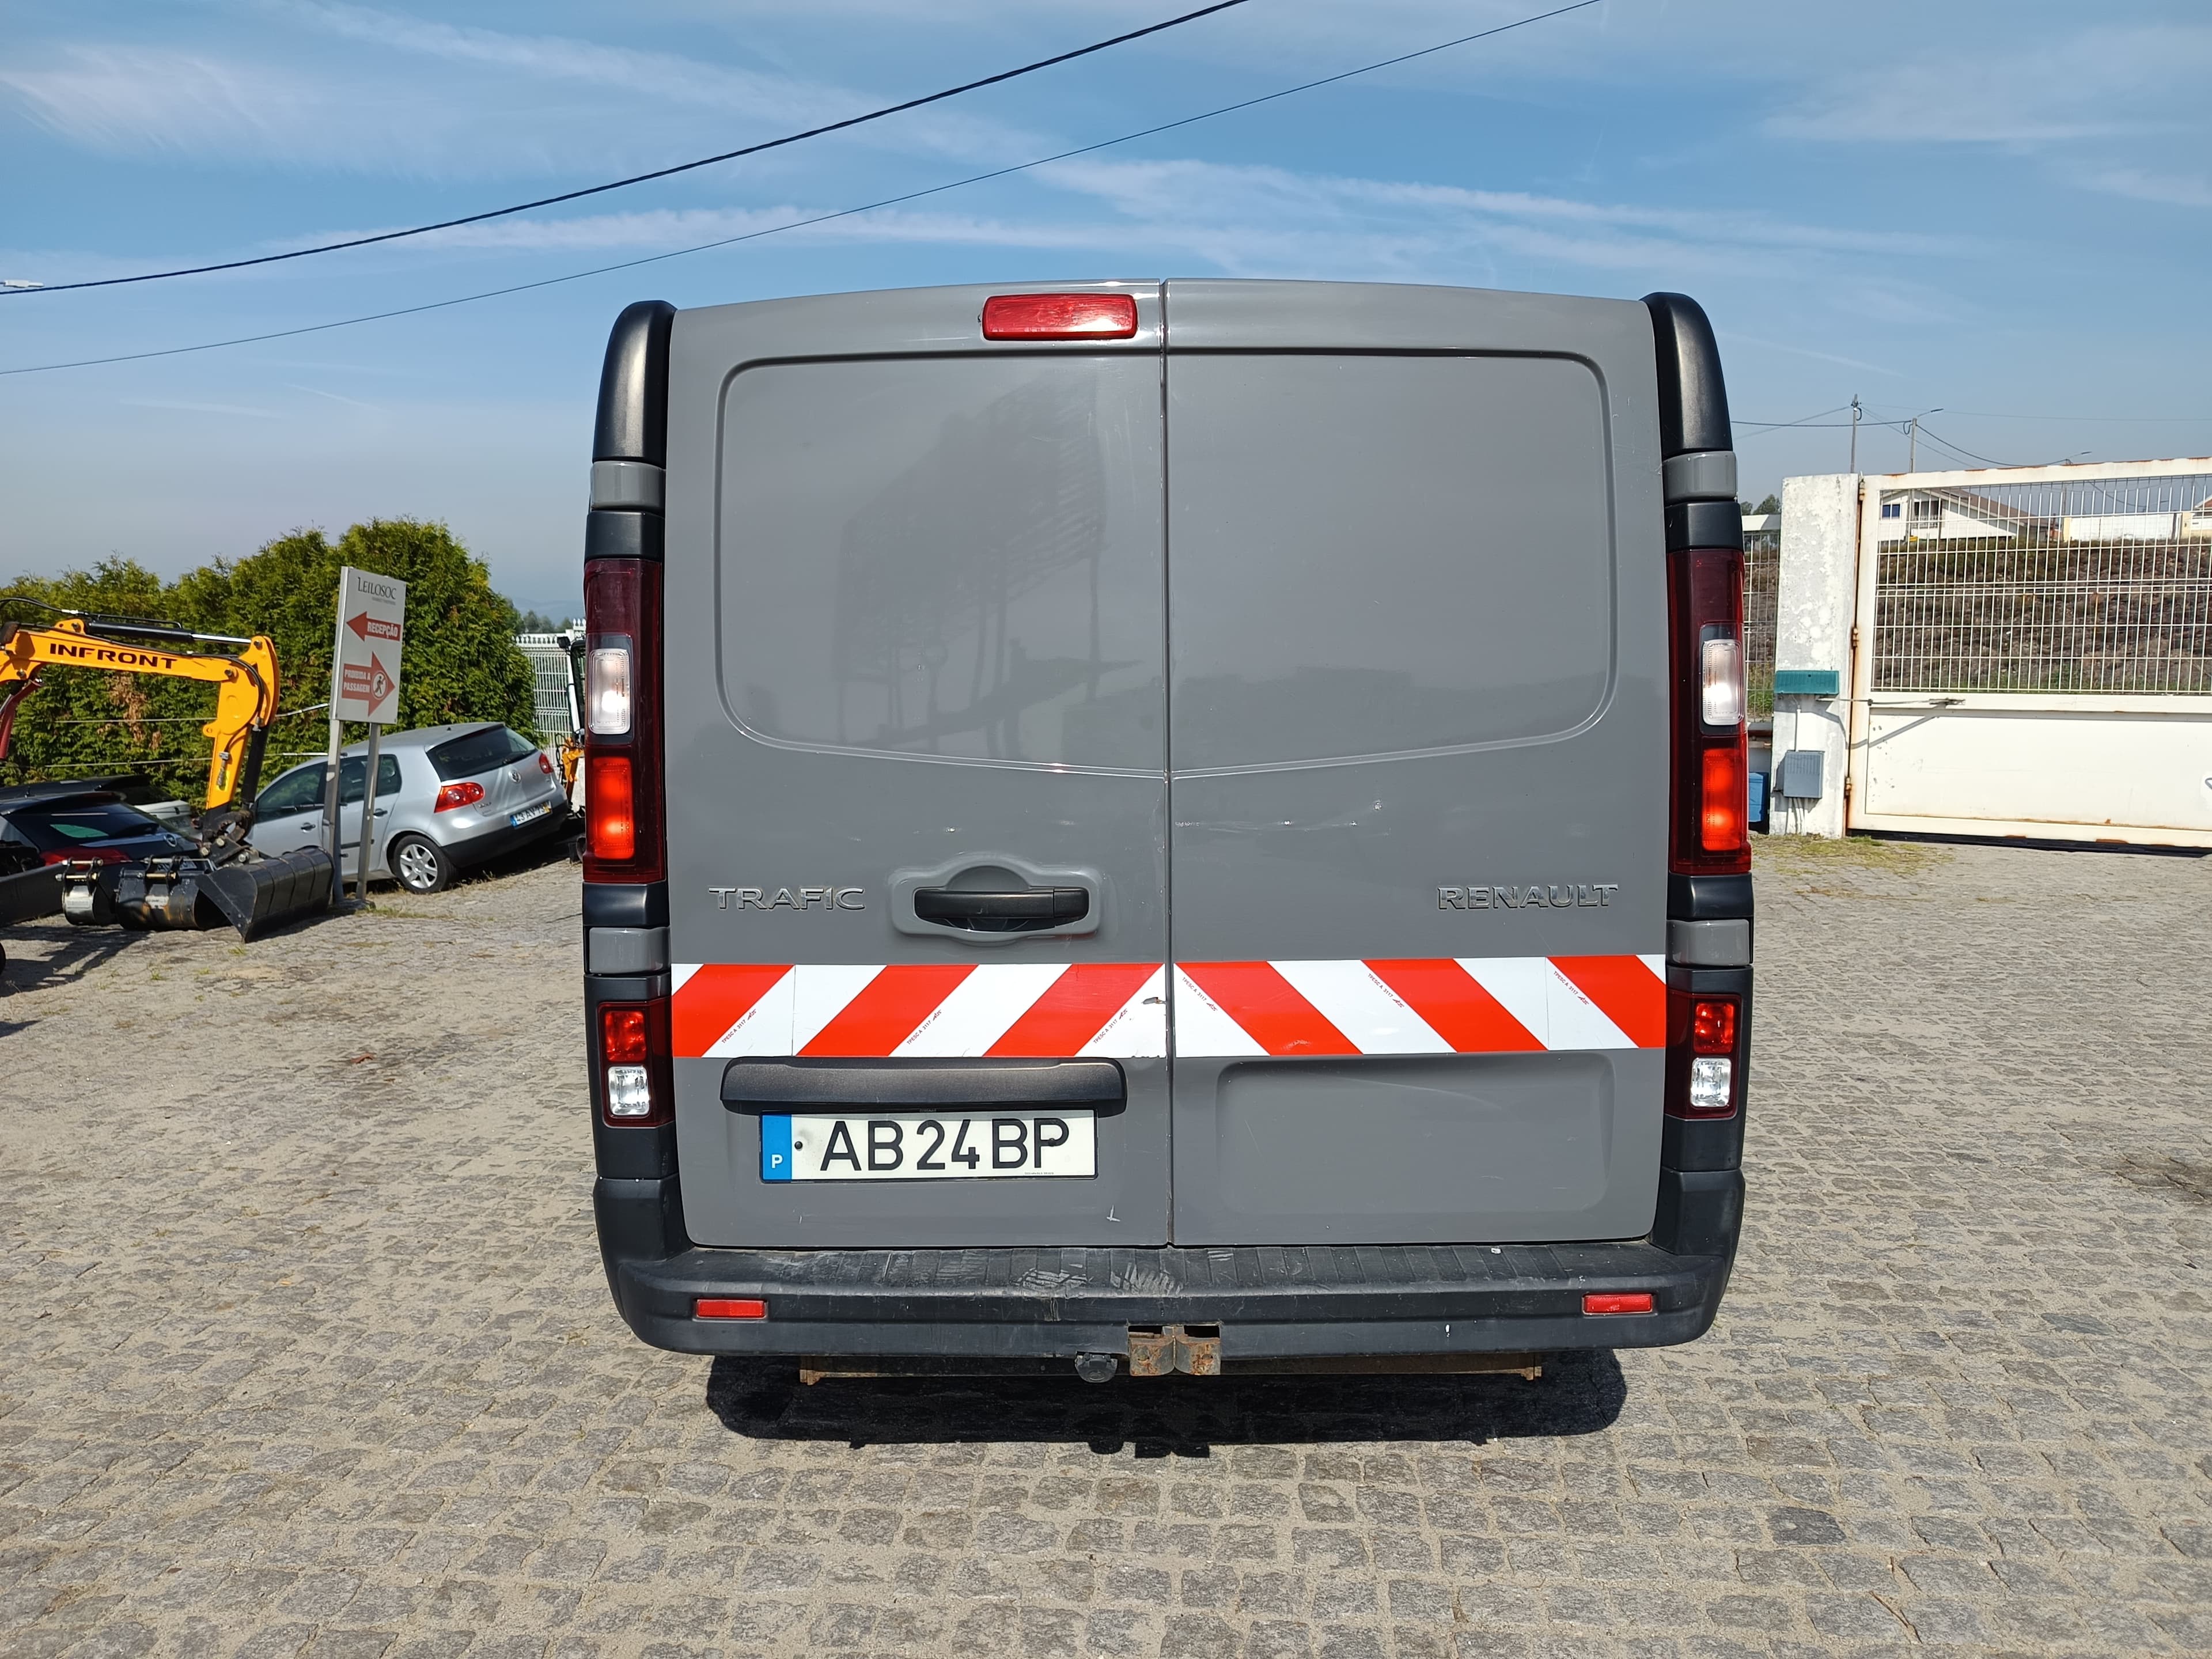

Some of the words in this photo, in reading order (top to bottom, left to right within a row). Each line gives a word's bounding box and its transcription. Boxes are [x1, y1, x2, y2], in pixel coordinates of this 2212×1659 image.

[358, 577, 397, 600] LEILOSOC
[367, 622, 399, 639] RECEPÇÃO
[50, 643, 177, 669] INFRONT
[709, 888, 865, 910] TRAFIC
[1438, 884, 1618, 910] RENAULT
[771, 1154, 783, 1169] P
